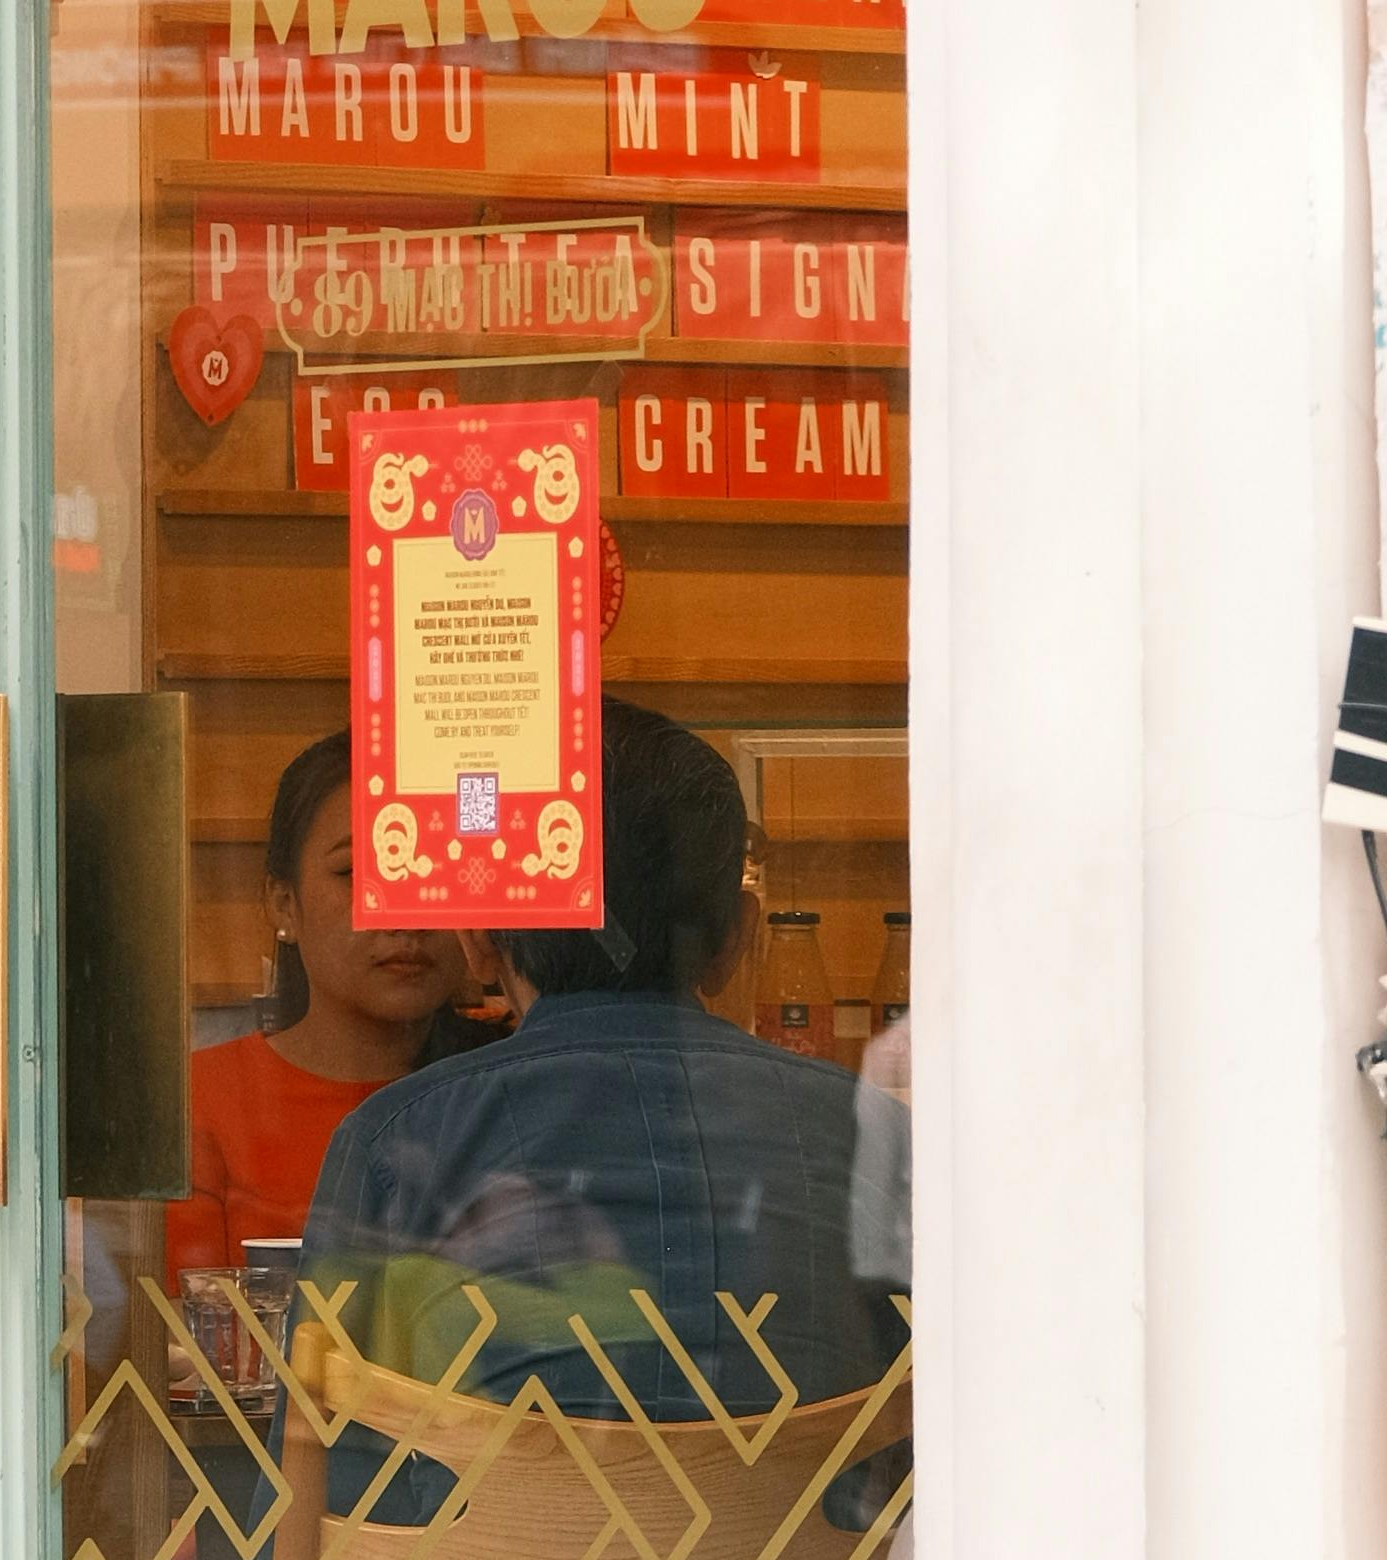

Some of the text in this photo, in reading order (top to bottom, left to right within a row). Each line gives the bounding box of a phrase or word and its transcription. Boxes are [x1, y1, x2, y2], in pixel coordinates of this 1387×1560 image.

[218, 56, 809, 160] MAROU MINT
[312, 270, 374, 338] 89
[634, 393, 883, 476] CREAM
